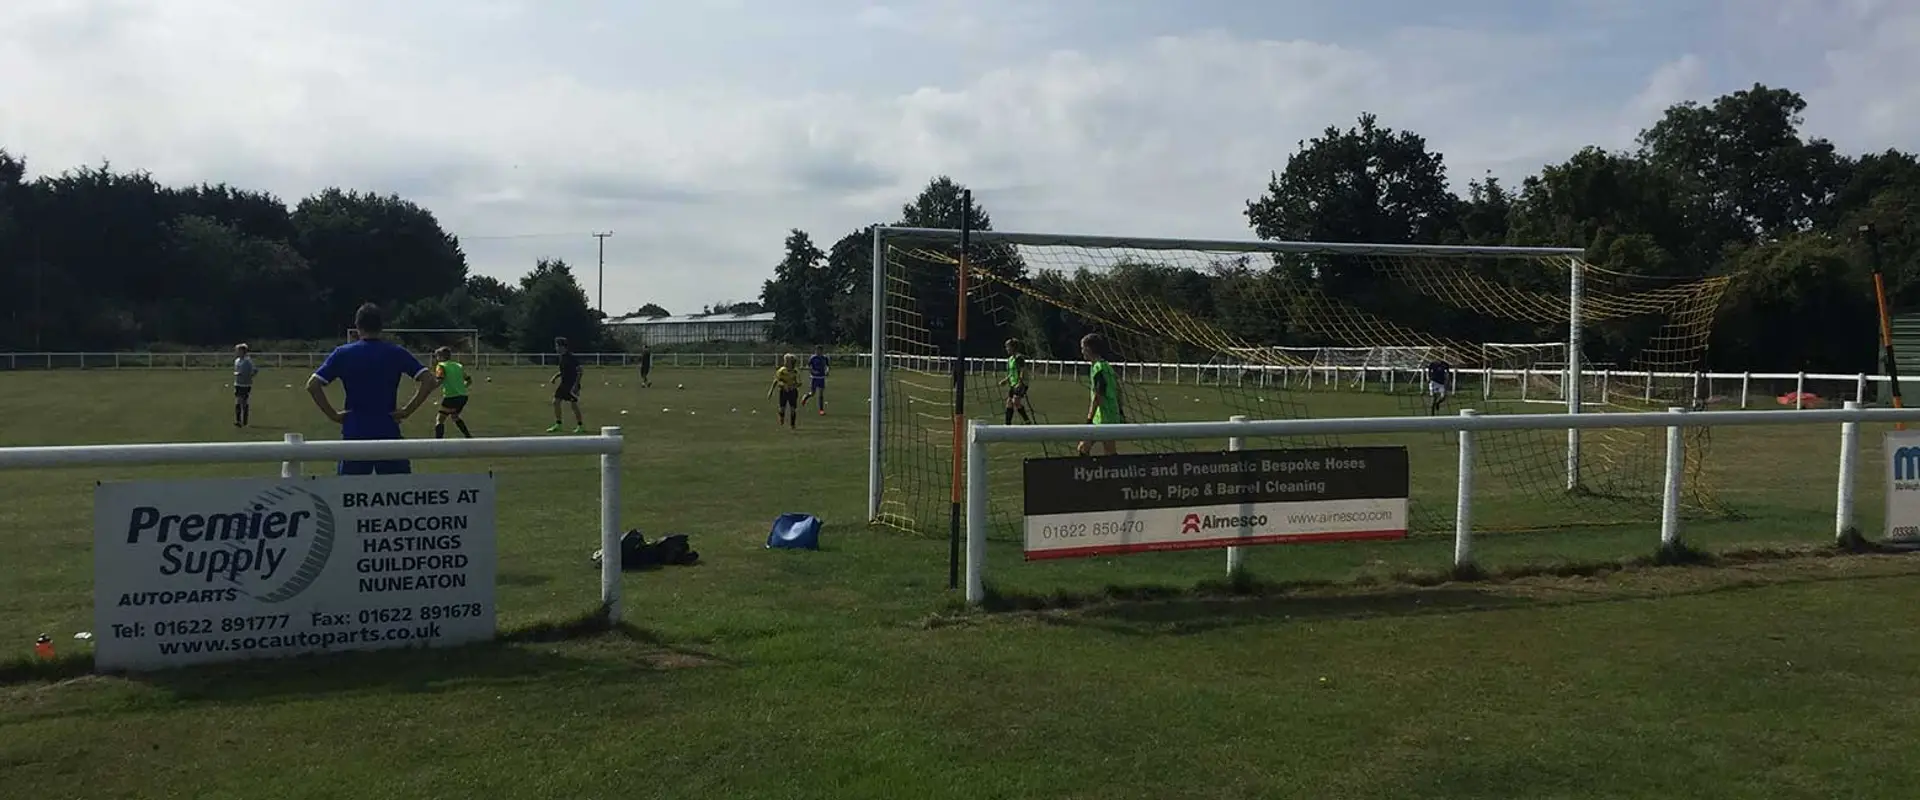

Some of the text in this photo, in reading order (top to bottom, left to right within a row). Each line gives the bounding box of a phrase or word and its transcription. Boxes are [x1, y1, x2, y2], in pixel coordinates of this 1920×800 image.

[1074, 457, 1366, 481] Hydraulic and Pneumatic Bespoke Hoses
[343, 489, 480, 508] BRANCHES AT
[1120, 480, 1325, 501] Tube, Pipe & Barrel Cleaning
[127, 504, 310, 544] Premier
[356, 515, 469, 534] HEADCORN
[1043, 520, 1144, 539] 01622 850470
[363, 535, 462, 553] HASTINGS
[159, 539, 287, 582] Supply
[356, 554, 469, 573] GUILDFORD
[358, 573, 466, 593] NUNEATON
[118, 587, 238, 607] AUTOPARTS
[311, 602, 482, 627] Fax: 01622 891678
[111, 614, 290, 639] Tel: 01622 891777
[158, 622, 441, 656] www.socautoparts.co.uk
